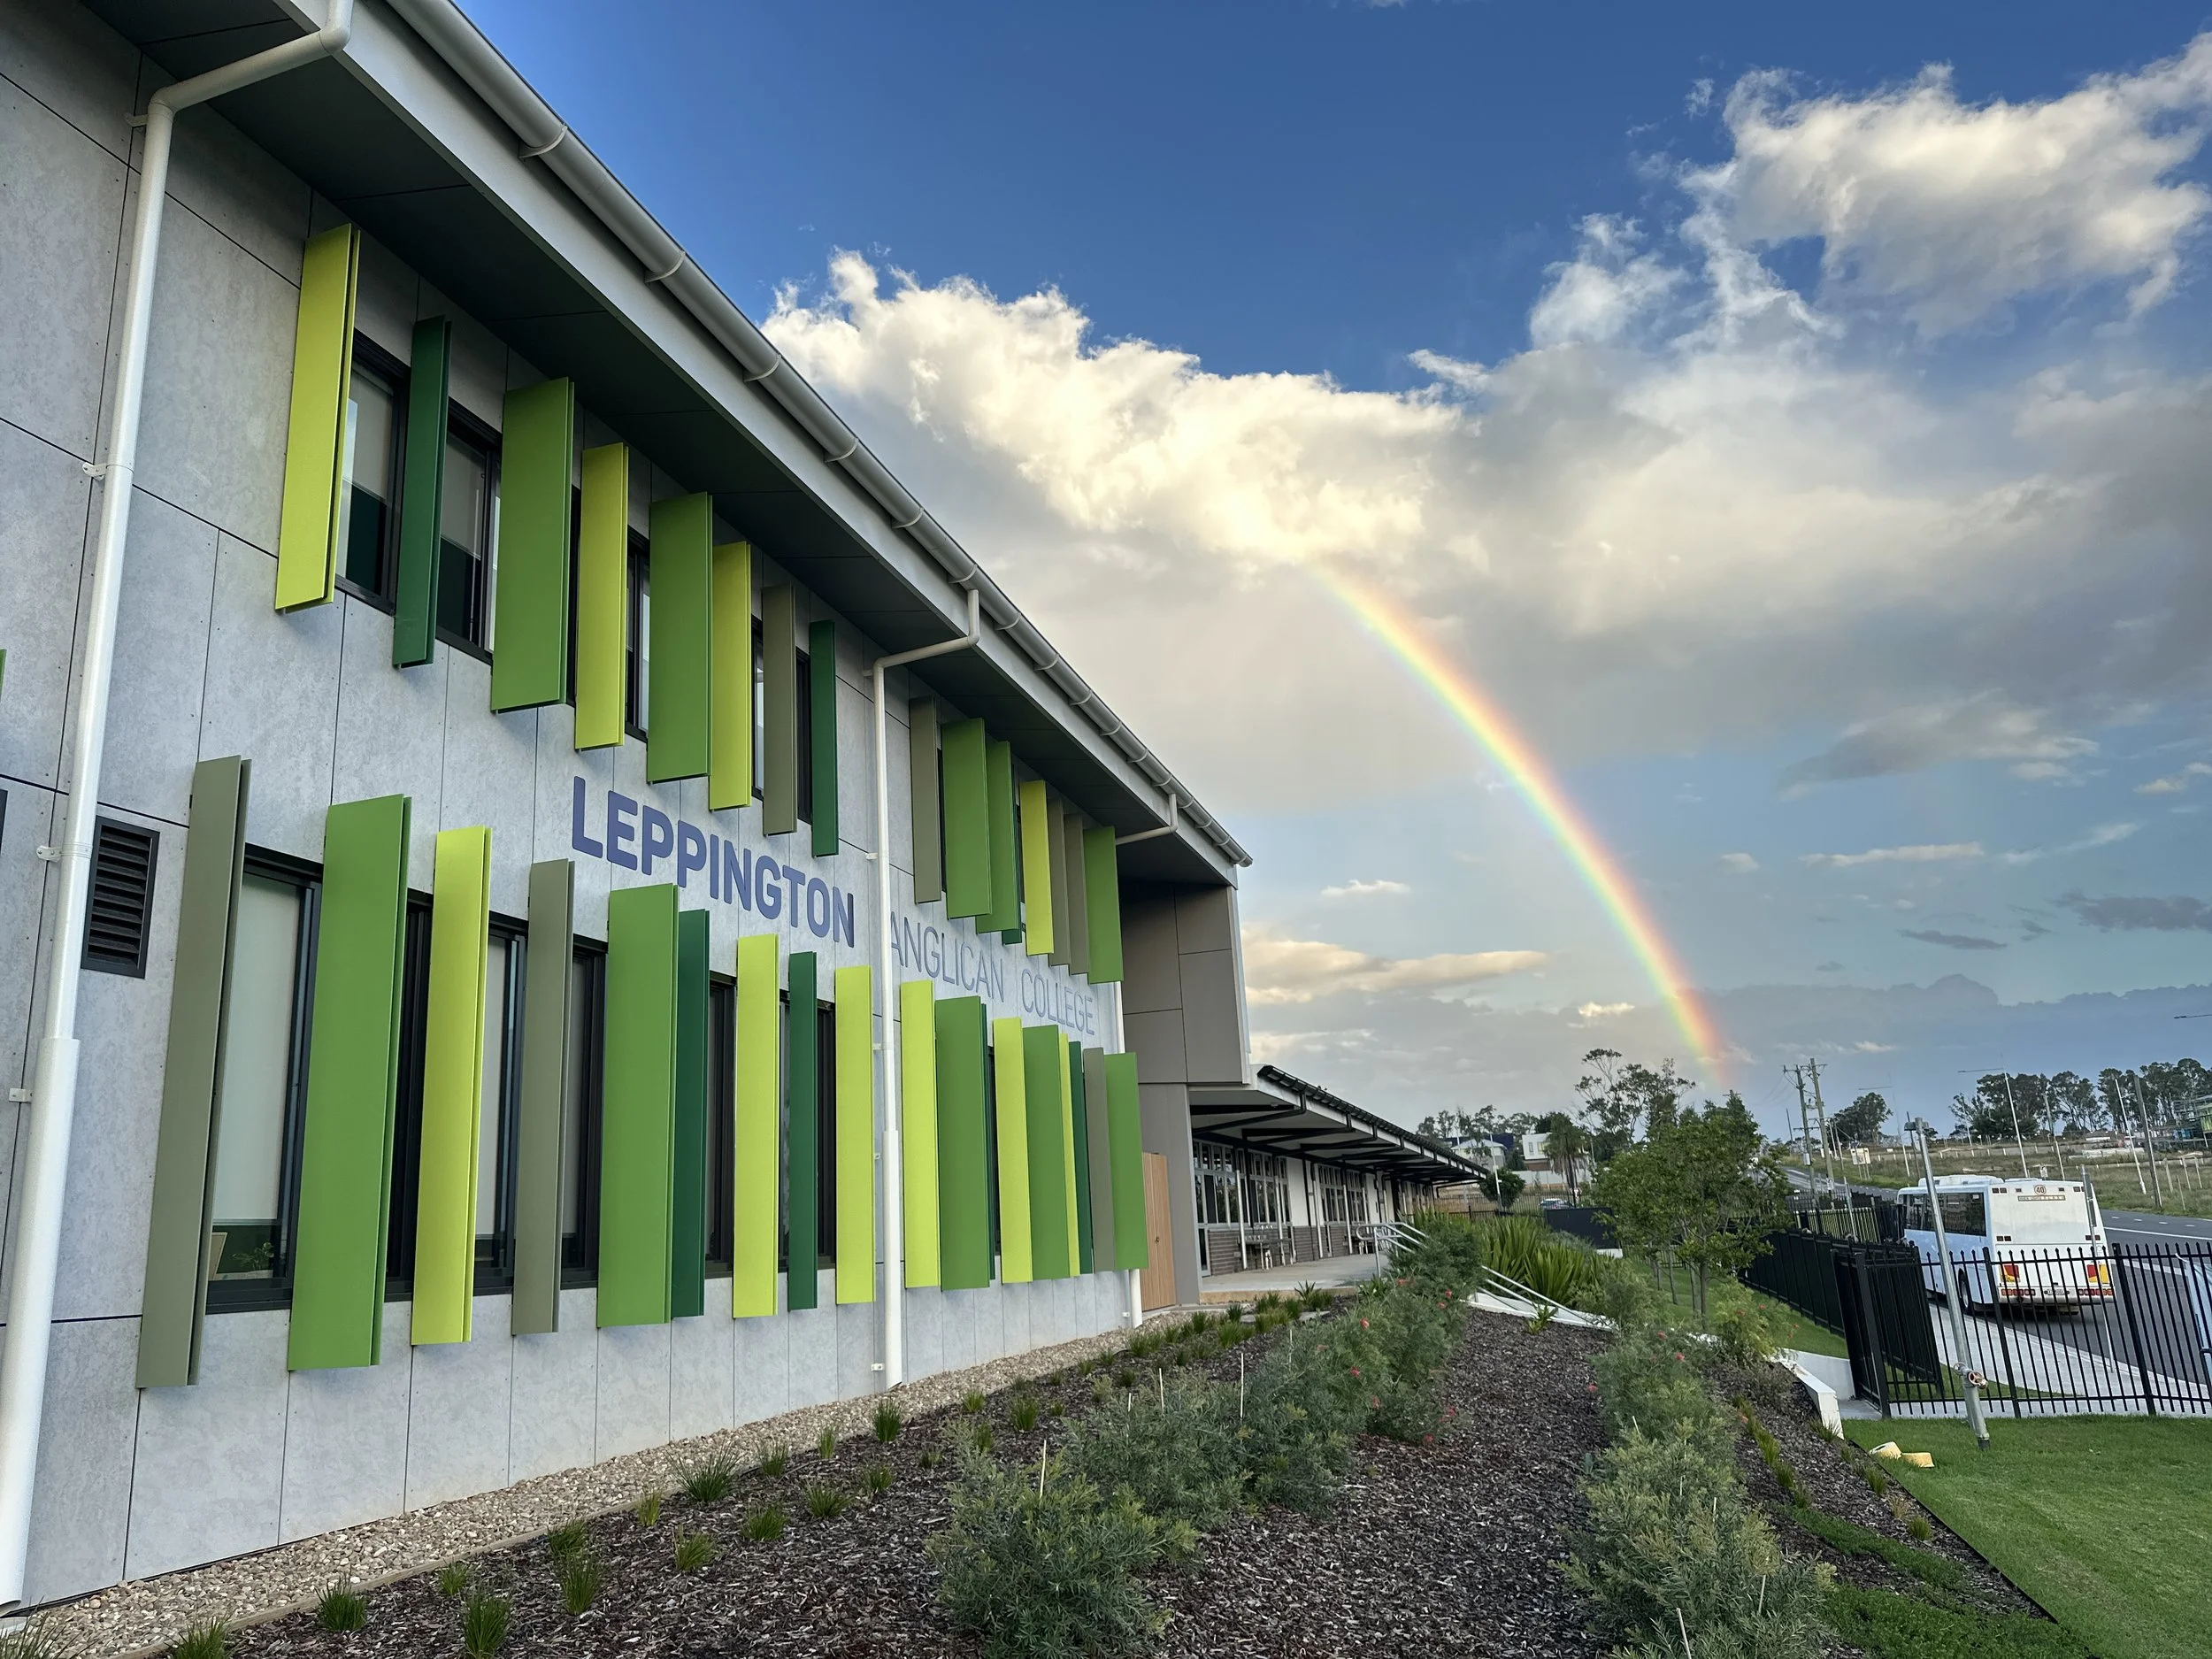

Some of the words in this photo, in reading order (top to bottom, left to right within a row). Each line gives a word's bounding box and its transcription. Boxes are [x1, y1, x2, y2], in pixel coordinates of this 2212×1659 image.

[572, 776, 855, 948] LEPPINGTON
[890, 911, 1005, 1002] ANGLICAN
[1021, 968, 1095, 1035] COLLEGE
